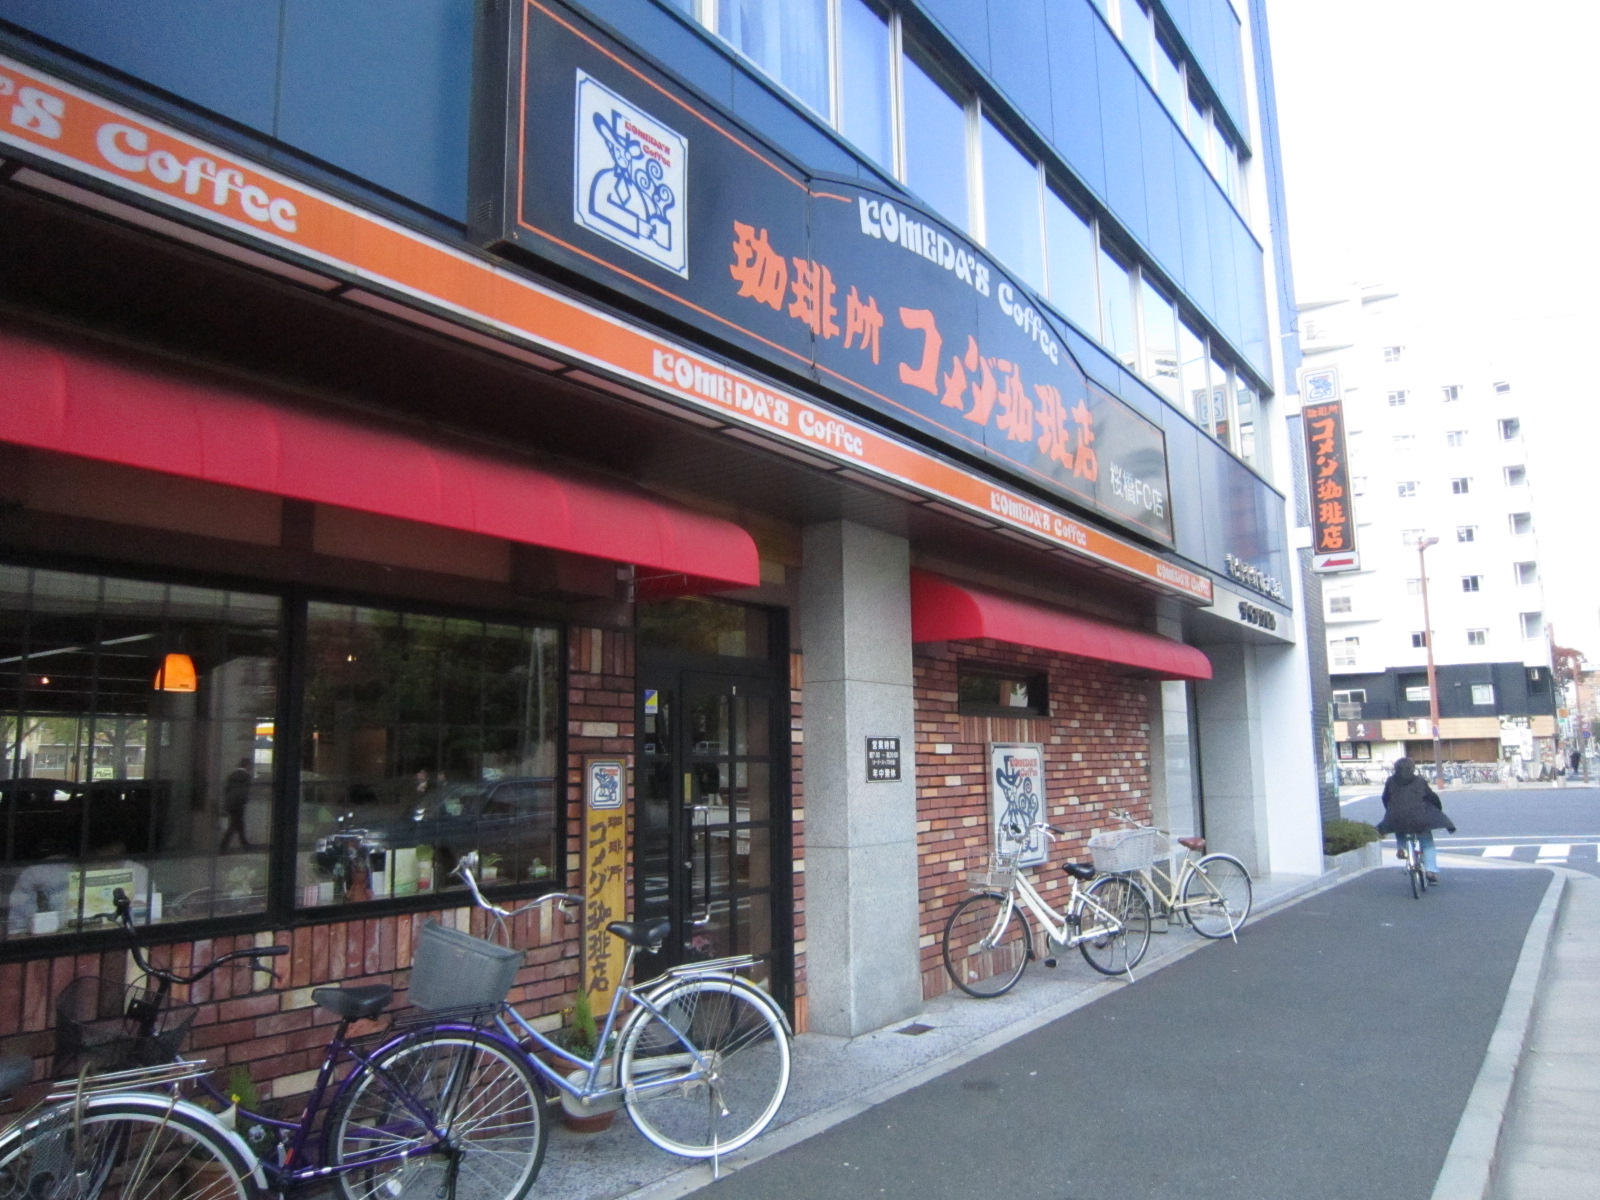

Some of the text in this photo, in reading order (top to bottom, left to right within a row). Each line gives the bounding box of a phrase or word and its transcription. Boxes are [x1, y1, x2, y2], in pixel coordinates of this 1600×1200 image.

[97, 123, 297, 233] Coffee
[858, 196, 1059, 366] KOMEDA'S Coffee
[652, 349, 863, 456] KOMEDA'S Coffee
[729, 219, 1098, 483] 珈琲所 コメダ珈琲店
[1054, 518, 1087, 546] Coffee
[1311, 417, 1346, 549] コメダ珈琲店
